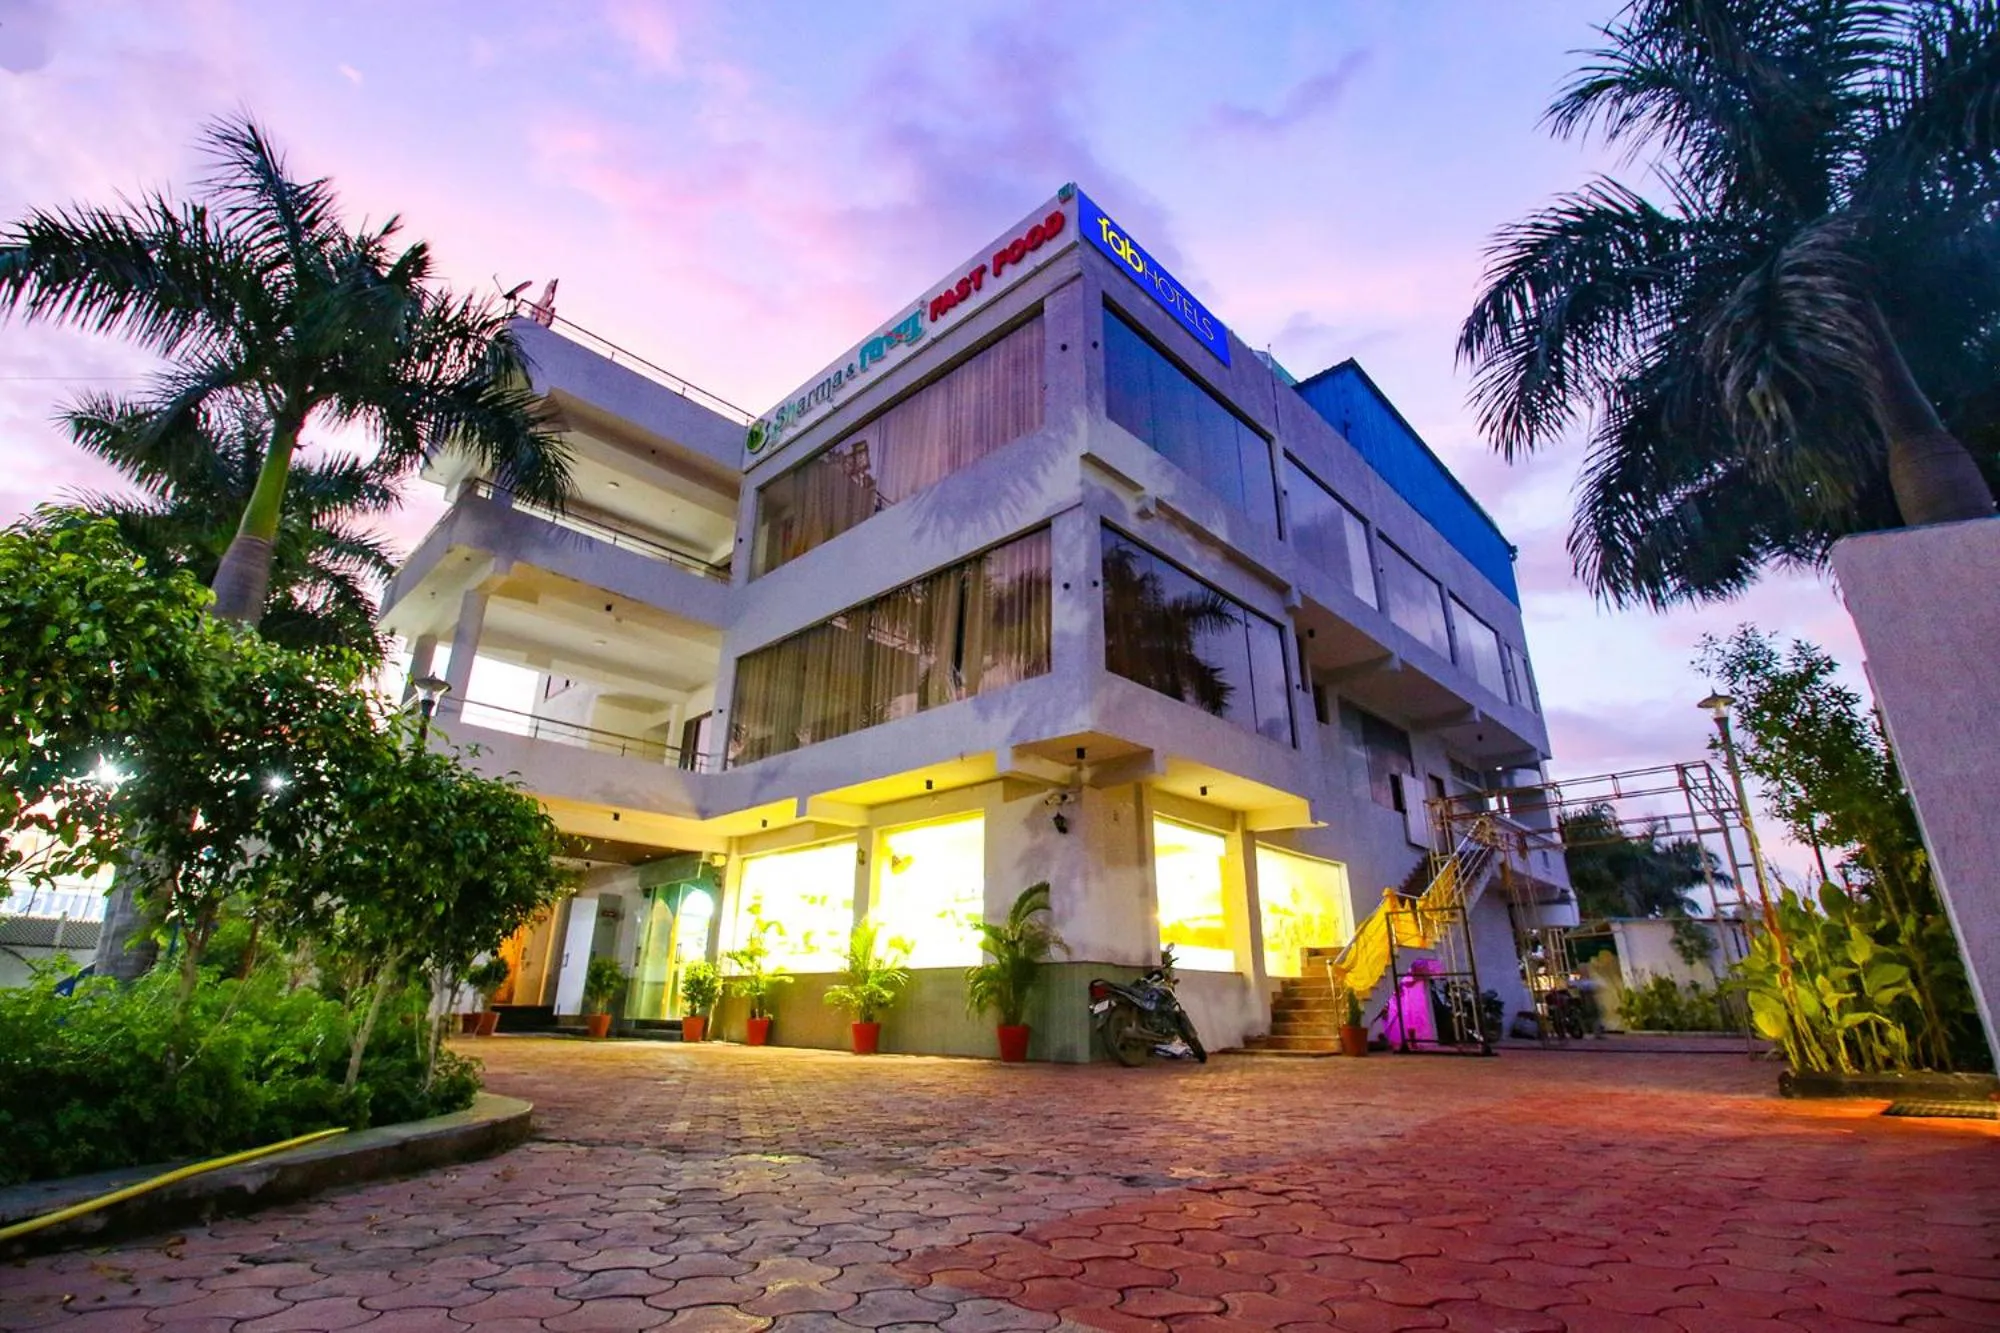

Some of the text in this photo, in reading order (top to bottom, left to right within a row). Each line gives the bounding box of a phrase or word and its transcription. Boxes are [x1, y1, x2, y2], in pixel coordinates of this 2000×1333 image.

[773, 369, 844, 432] Sharma
[930, 263, 987, 323] FAST
[993, 210, 1065, 278] FOOD
